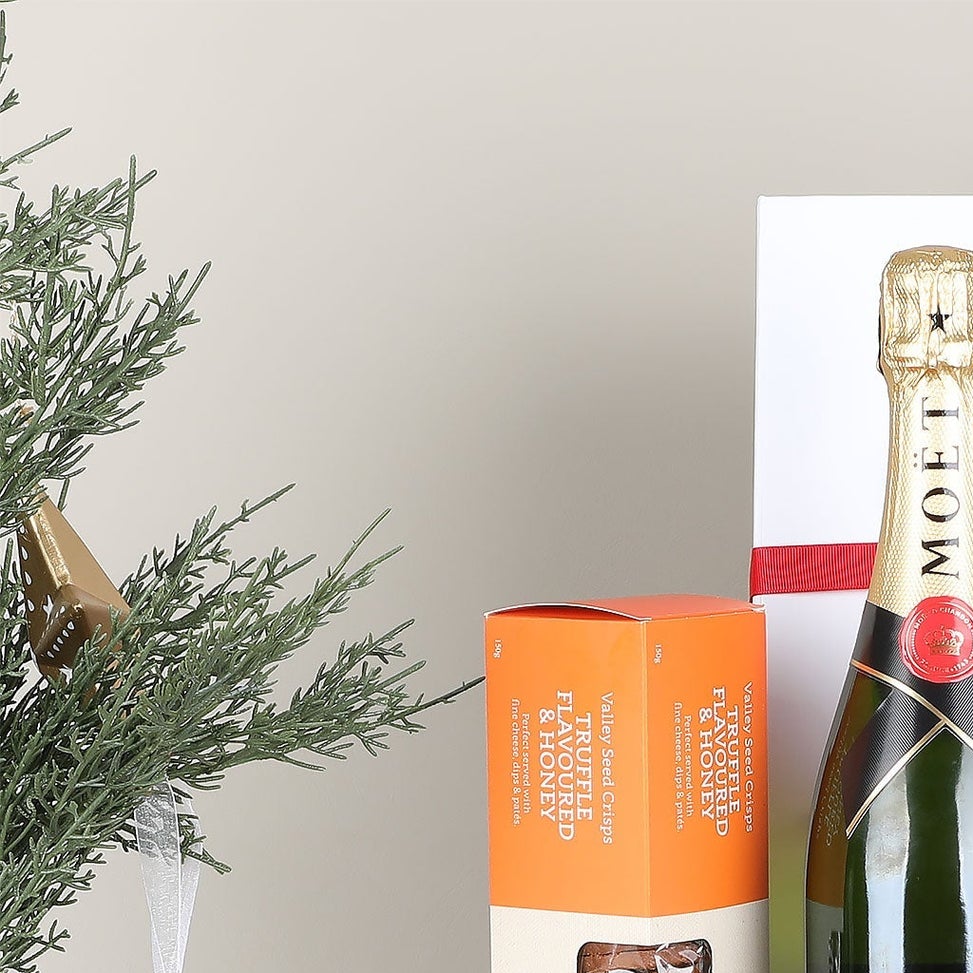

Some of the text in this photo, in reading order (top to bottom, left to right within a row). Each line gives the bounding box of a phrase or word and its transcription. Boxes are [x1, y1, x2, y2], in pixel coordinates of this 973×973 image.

[914, 396, 960, 578] MOËT
[493, 639, 502, 658] 150g
[653, 644, 663, 664] 150g
[940, 607, 973, 629] CHANDON
[511, 698, 520, 720] fine
[675, 702, 684, 723] fine
[727, 705, 740, 813] TRUFFLE
[743, 681, 754, 833] Valley Seed Crisps
[510, 762, 521, 785] dips
[511, 787, 520, 795] &
[522, 713, 531, 814] Perfect served with
[540, 708, 556, 822] & HONEY
[556, 690, 574, 841] FLAVOURED
[575, 712, 592, 821] TRUFFLE
[599, 692, 615, 844] Valley Seed Crisps
[674, 766, 684, 790] dips
[675, 791, 683, 800] &
[684, 715, 694, 817] Perfect served with
[699, 707, 714, 820] & HONEY
[713, 687, 729, 837] FLAVOURED
